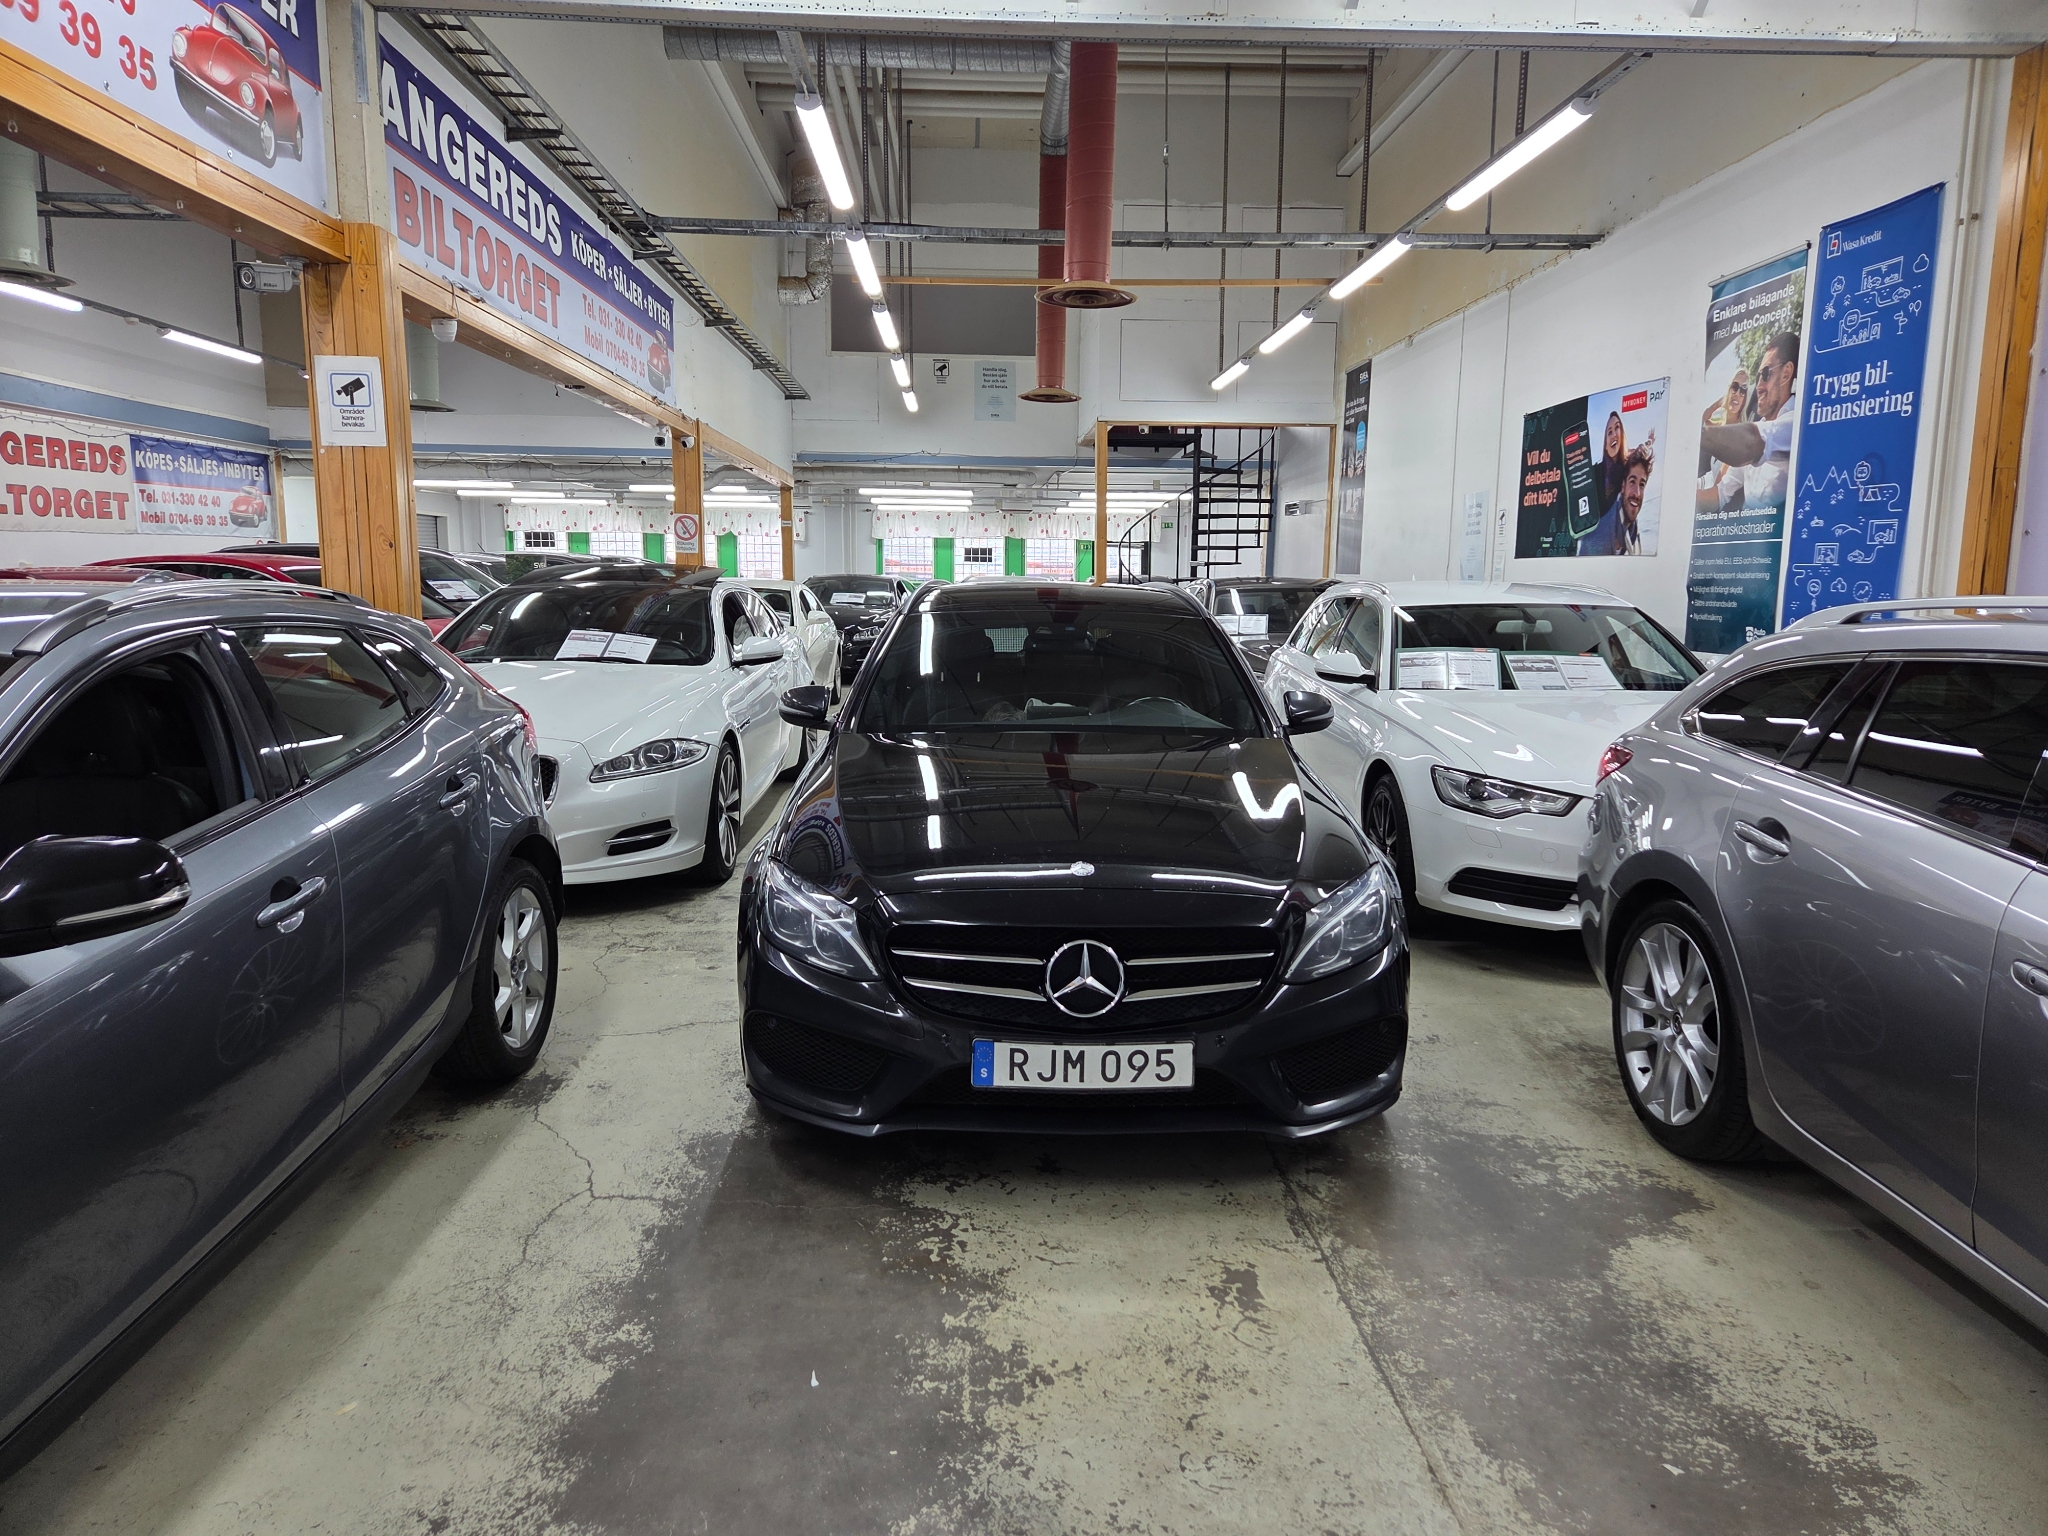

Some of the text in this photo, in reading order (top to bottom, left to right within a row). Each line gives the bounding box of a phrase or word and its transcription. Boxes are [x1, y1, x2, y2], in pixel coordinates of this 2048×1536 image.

[58, 0, 158, 91] 39 35
[380, 59, 671, 332] ANGEREDS KÖPER SÄLJER BYTER
[393, 166, 561, 329] BILTORGET
[1843, 230, 1882, 252] Wasa Kredit
[1713, 283, 1795, 323] Enklare bilägande
[582, 292, 597, 321] Tel.
[627, 325, 634, 347] 42
[1713, 303, 1792, 341] med AutoConcept
[1812, 359, 1893, 399] Trygg bil-
[1622, 389, 1666, 408] MYMONEY PAY
[1808, 390, 1914, 425] finansiering
[339, 407, 366, 416] Området
[0, 431, 127, 476] GEREDS
[135, 448, 265, 481] KÖPES SÄLJES INBYTES
[1527, 450, 1540, 466] Vill
[1540, 448, 1551, 464] du
[1525, 467, 1561, 487] delbetala
[138, 488, 159, 504] Tel.
[198, 494, 209, 507] 42
[211, 496, 221, 508] 40
[1523, 488, 1558, 507] ditt köp?
[140, 511, 166, 524] Mobil
[206, 515, 216, 526] 39
[218, 516, 229, 527] 35
[1719, 510, 1728, 520] dig
[1728, 509, 1740, 518] mot
[1740, 506, 1777, 517] oförutsedda
[1694, 520, 1777, 540] reparationskostnader
[1753, 627, 1767, 636] Auto
[980, 1067, 988, 1079] S
[1008, 1047, 1176, 1083] RJM 095
